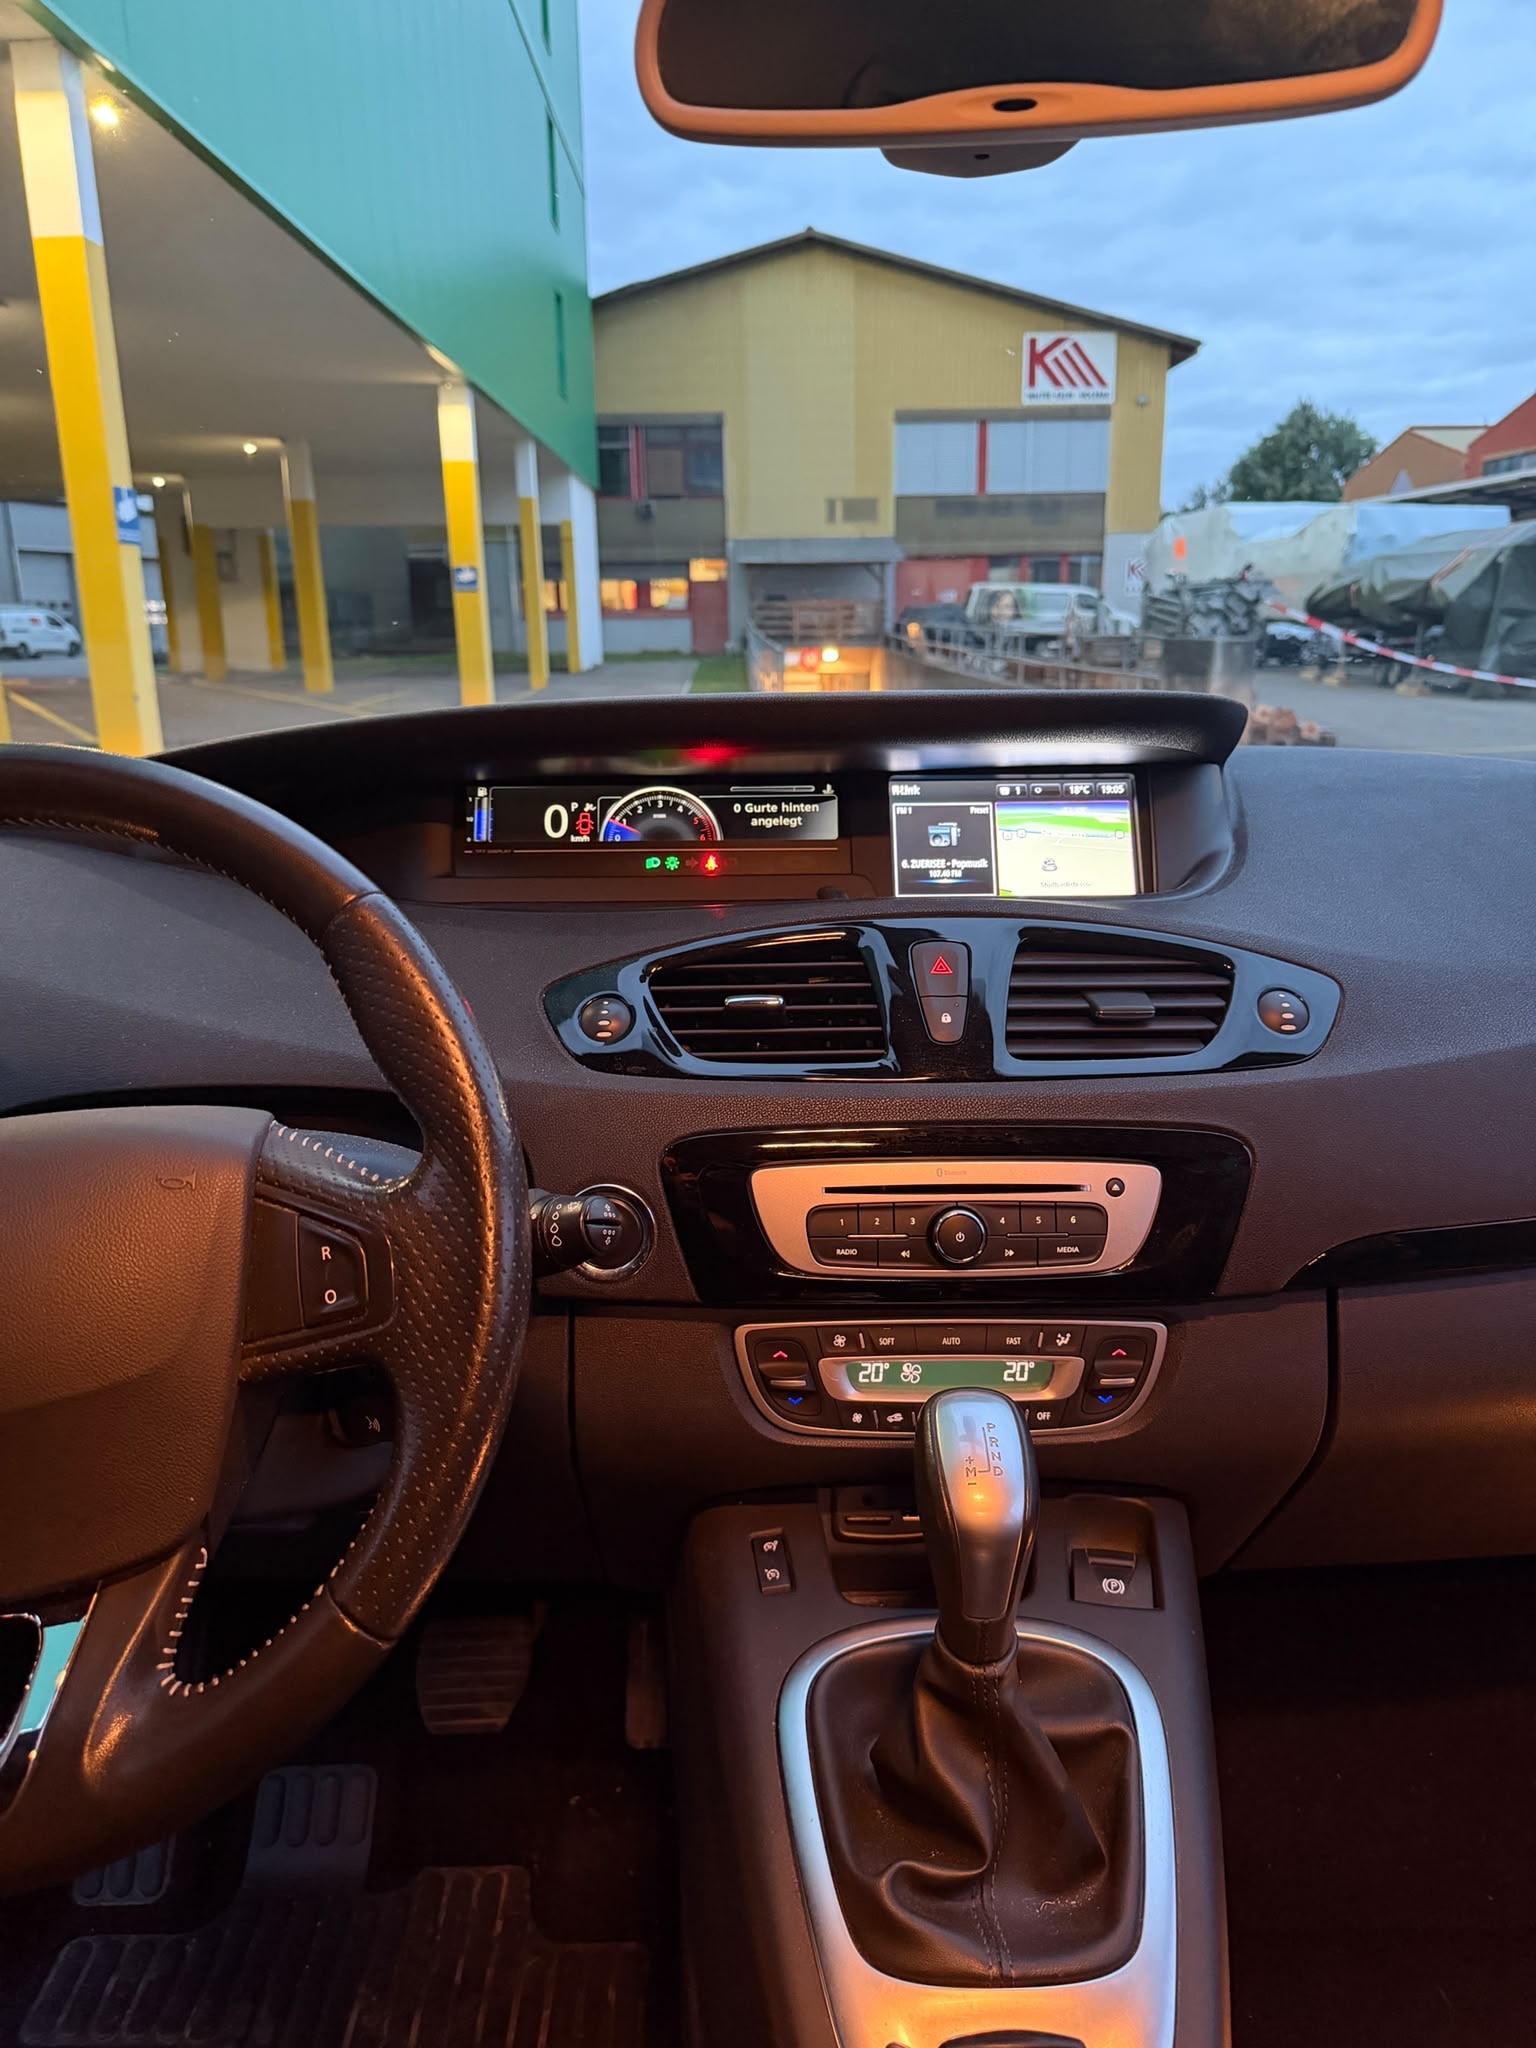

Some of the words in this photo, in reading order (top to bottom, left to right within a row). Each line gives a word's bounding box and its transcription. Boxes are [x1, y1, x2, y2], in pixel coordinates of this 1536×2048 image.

[571, 802, 578, 812] P
[733, 803, 741, 813] 0
[744, 803, 778, 813] Gurte
[781, 802, 819, 812] hinten
[544, 804, 569, 838] 0
[751, 816, 803, 828] angelegt
[910, 1217, 916, 1225] 3
[1000, 1216, 1005, 1224] 4
[1036, 1216, 1041, 1224] 5
[1070, 1216, 1076, 1224] 6
[321, 1246, 332, 1260] R
[836, 1248, 858, 1256] RADIO
[1056, 1246, 1080, 1254] MEDIA
[878, 1337, 895, 1346] SOFT
[942, 1336, 961, 1346] AUTO
[1006, 1336, 1021, 1345] FAST
[1037, 1411, 1051, 1421] OFF
[986, 1423, 996, 1433] P
[989, 1436, 999, 1447] R
[991, 1451, 1002, 1462] N
[965, 1466, 977, 1478] M
[993, 1466, 1004, 1477] D
